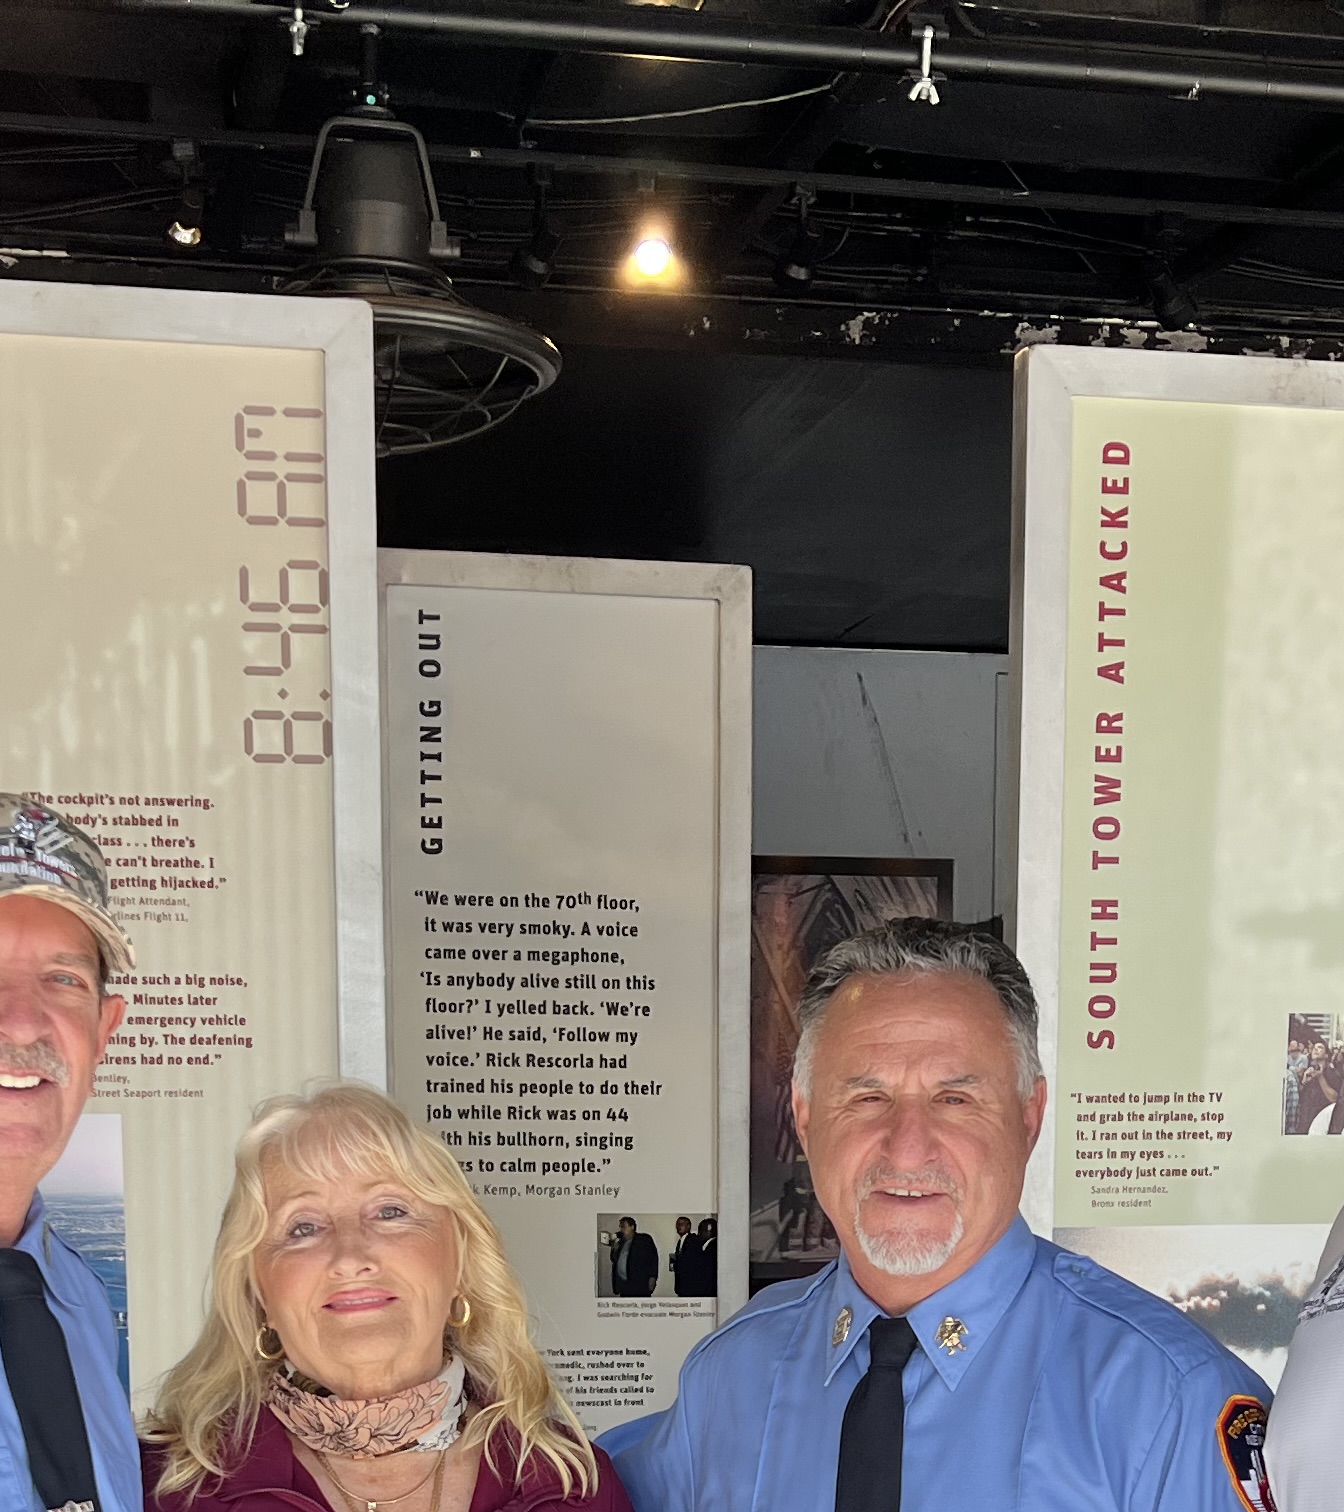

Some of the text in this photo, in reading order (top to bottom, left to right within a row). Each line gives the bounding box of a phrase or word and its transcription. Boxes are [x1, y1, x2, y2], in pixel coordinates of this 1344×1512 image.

[235, 405, 333, 765] 8:46 AM
[419, 609, 443, 855] GETTING OUT
[1088, 442, 1130, 1048] SOUTH TOWER ATTACKED
[57, 792, 115, 808] cockpit's
[119, 795, 140, 807] not
[144, 794, 215, 811] answering.
[112, 814, 163, 827] stabbed
[167, 815, 179, 827] in
[115, 855, 215, 869] can't breathe. I
[110, 875, 227, 891] getting hijacked."
[138, 896, 190, 908] Attendant,
[414, 890, 639, 913] "We were on the 70th floor,
[141, 974, 170, 985] such
[174, 976, 181, 985] a
[185, 974, 206, 989] big
[209, 974, 248, 988] noise,
[420, 971, 655, 991] 'Is anybody alive still on this
[133, 994, 218, 1006] Minutes later
[127, 1014, 246, 1028] emergency vehicle
[140, 1033, 253, 1049] by. The deafening
[426, 1051, 627, 1069] voice.' Rick Rescorla had
[123, 1088, 161, 1099] Seaport
[164, 1088, 204, 1098] resident
[426, 1078, 662, 1098] trained his people to do their
[1070, 1091, 1223, 1106] "I wanted to jump in the TV
[1075, 1166, 1219, 1180] everybody just came out."
[483, 1183, 620, 1199] Kemp, Morgan Stanley
